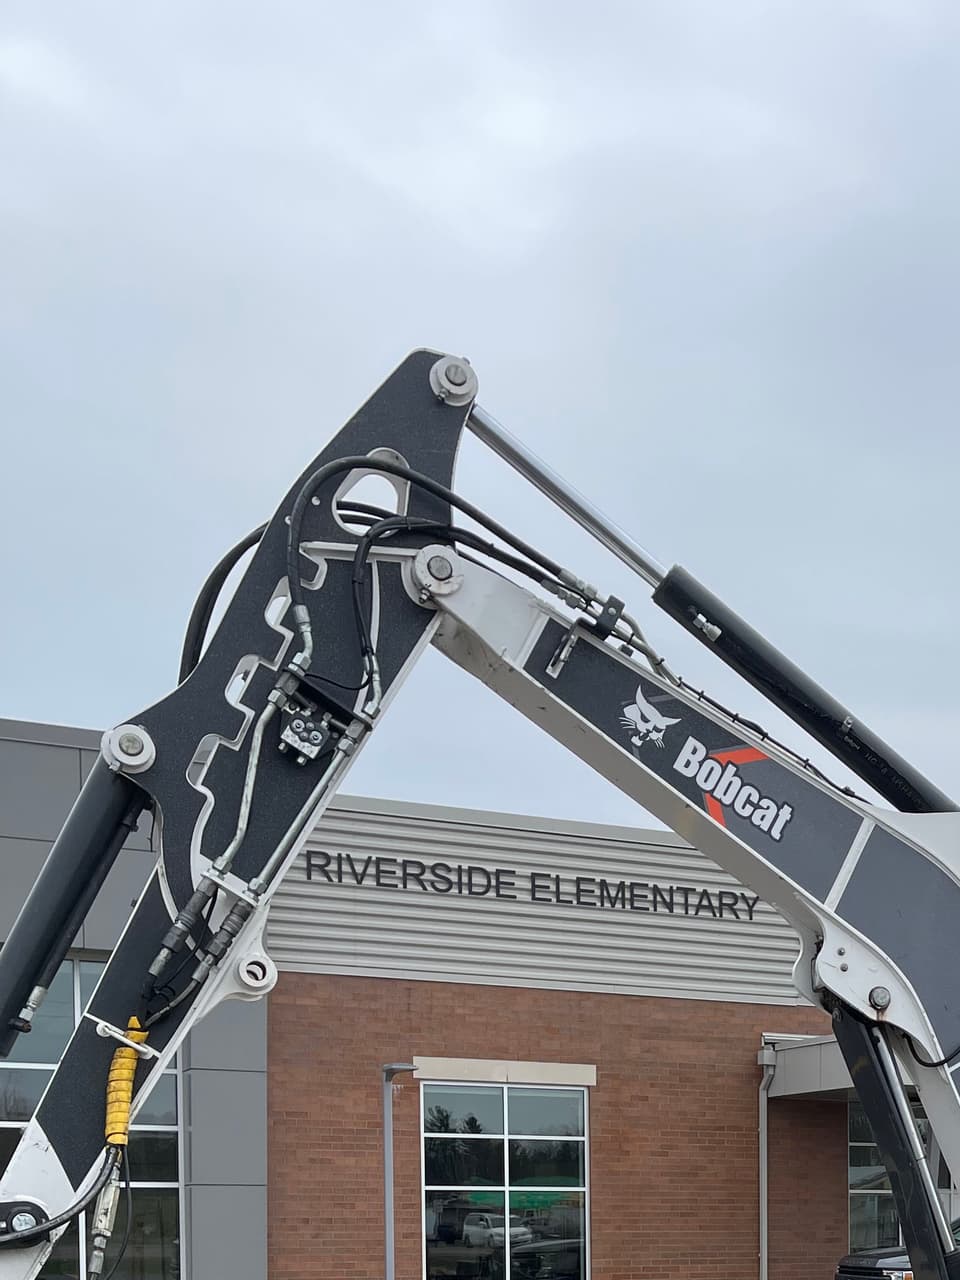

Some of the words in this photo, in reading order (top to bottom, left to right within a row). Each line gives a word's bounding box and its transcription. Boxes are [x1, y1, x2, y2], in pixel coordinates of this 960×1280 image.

[672, 735, 793, 841] Bobcat
[305, 849, 517, 899] RIVERSIDE
[530, 872, 760, 921] ELEMENTARY
